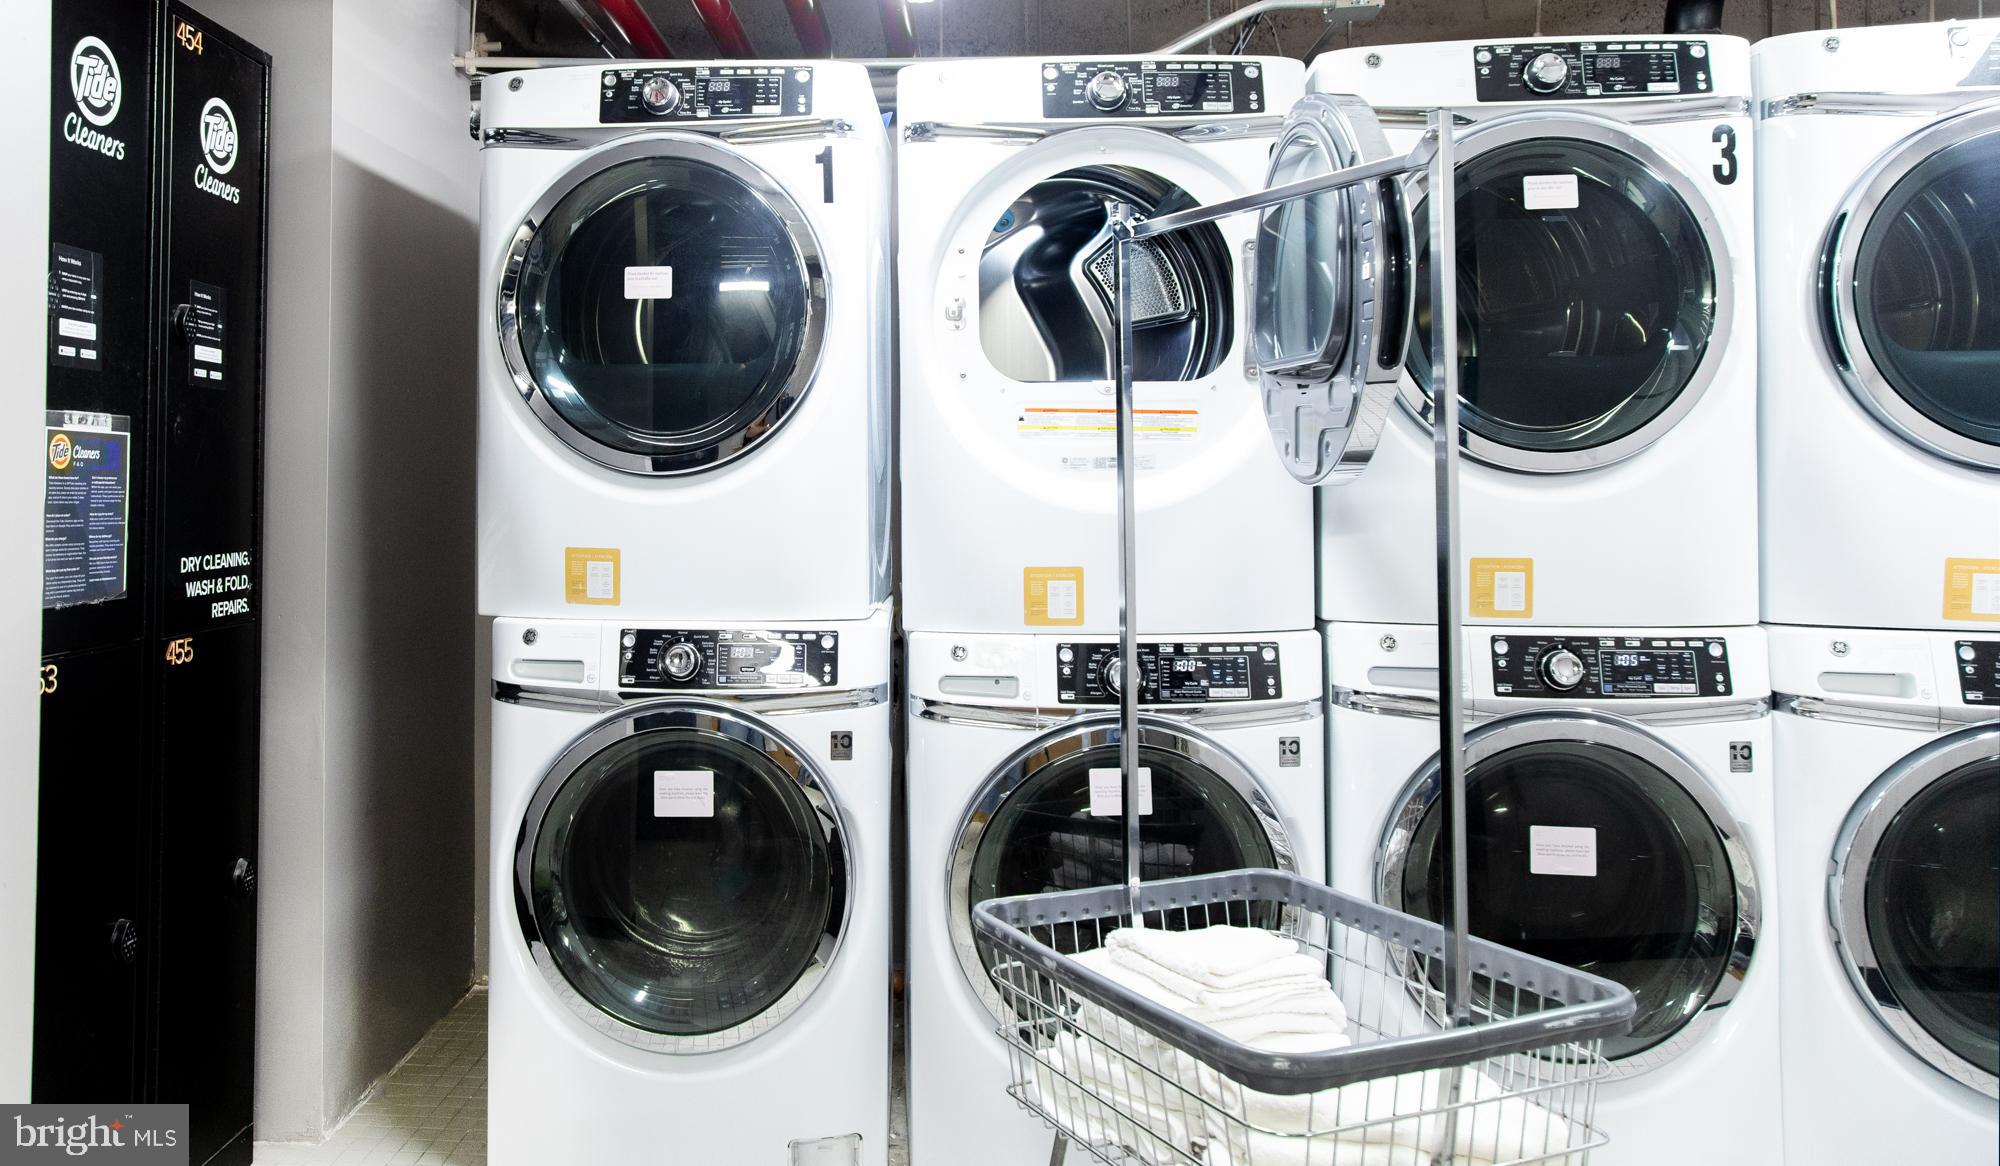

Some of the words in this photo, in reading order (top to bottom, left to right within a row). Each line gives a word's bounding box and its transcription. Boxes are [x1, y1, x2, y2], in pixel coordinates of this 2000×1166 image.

[176, 22, 203, 55] 454
[76, 55, 118, 102] Tide
[64, 112, 125, 160] Cleaners
[204, 114, 235, 154] Tide
[1712, 124, 1738, 185] 3
[194, 164, 240, 204] Cleaners
[815, 145, 835, 204] 1
[52, 443, 69, 462] Tide
[73, 445, 101, 459] Cleaners
[180, 555, 202, 573] DRY
[203, 551, 250, 570] CLEANING.
[185, 579, 215, 598] WASH
[216, 578, 223, 593] &
[225, 575, 249, 592] FOLD.
[211, 598, 250, 618] REPAIRS.
[166, 638, 193, 665] 455
